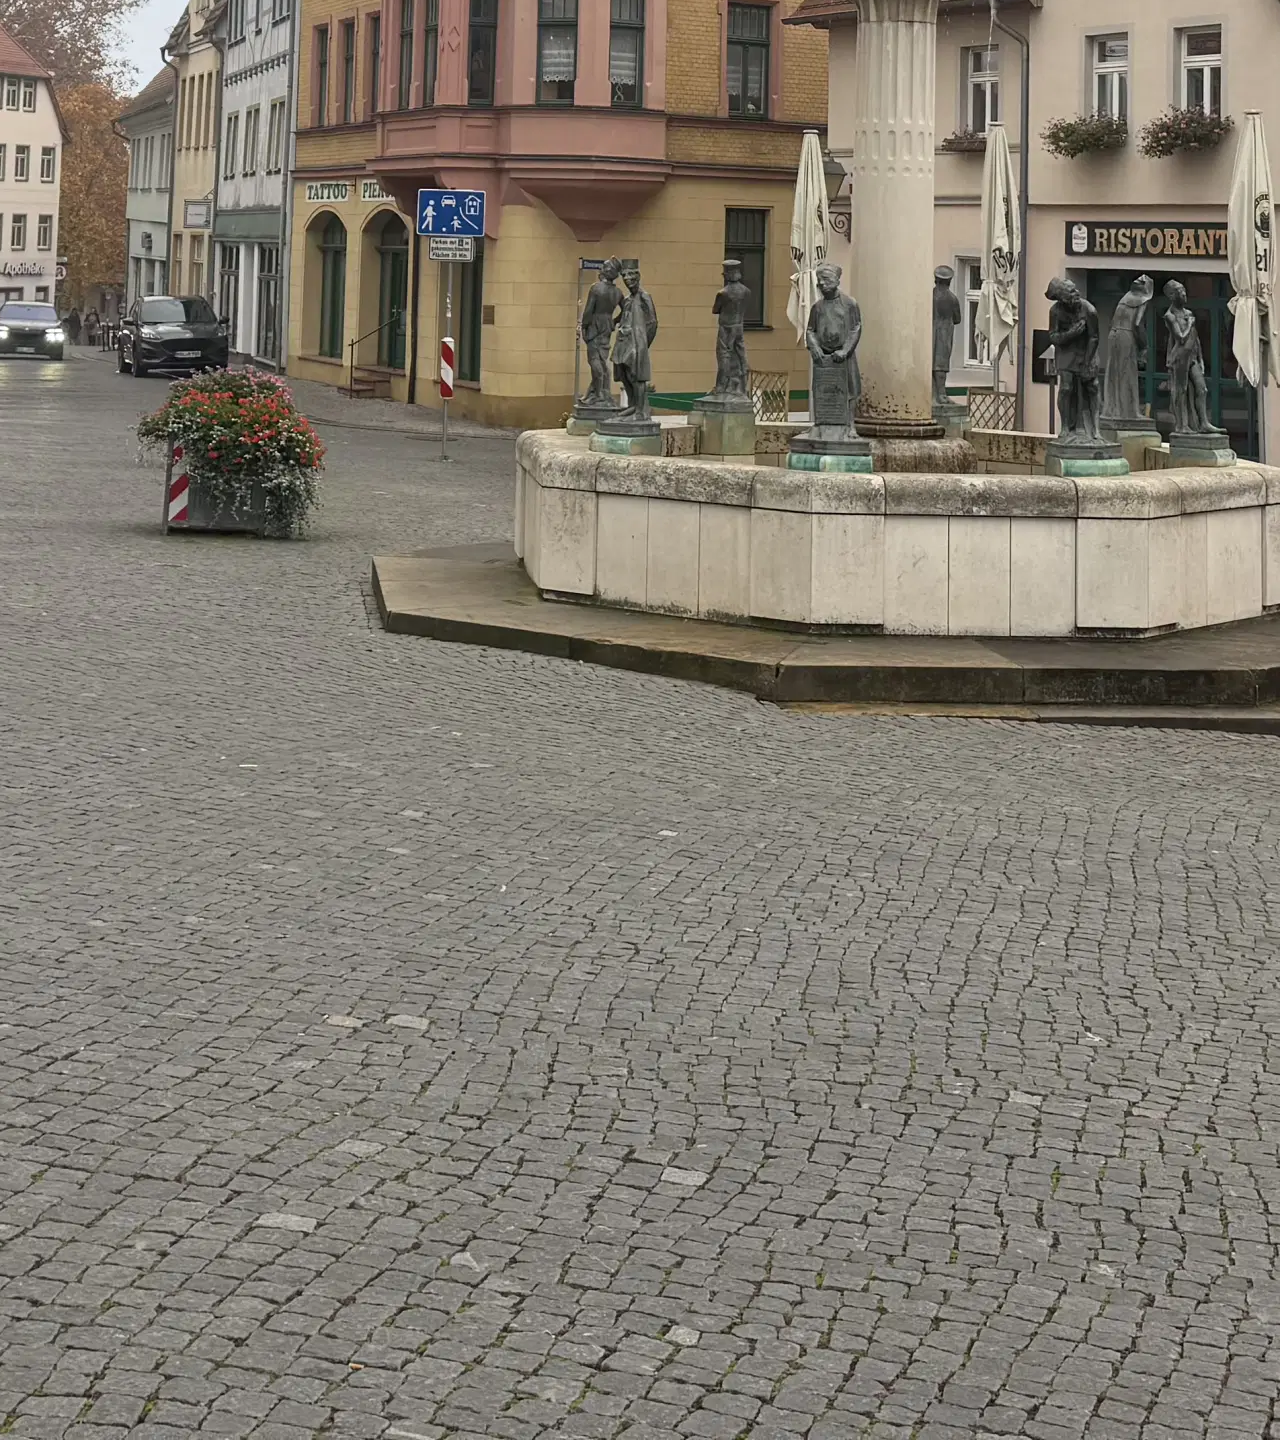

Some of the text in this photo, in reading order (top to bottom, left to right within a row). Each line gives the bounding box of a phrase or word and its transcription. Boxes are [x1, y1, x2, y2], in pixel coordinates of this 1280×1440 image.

[307, 183, 348, 200] TATTOO
[1094, 227, 1228, 255] RISTORANT
[5, 262, 45, 277] Apotheke
